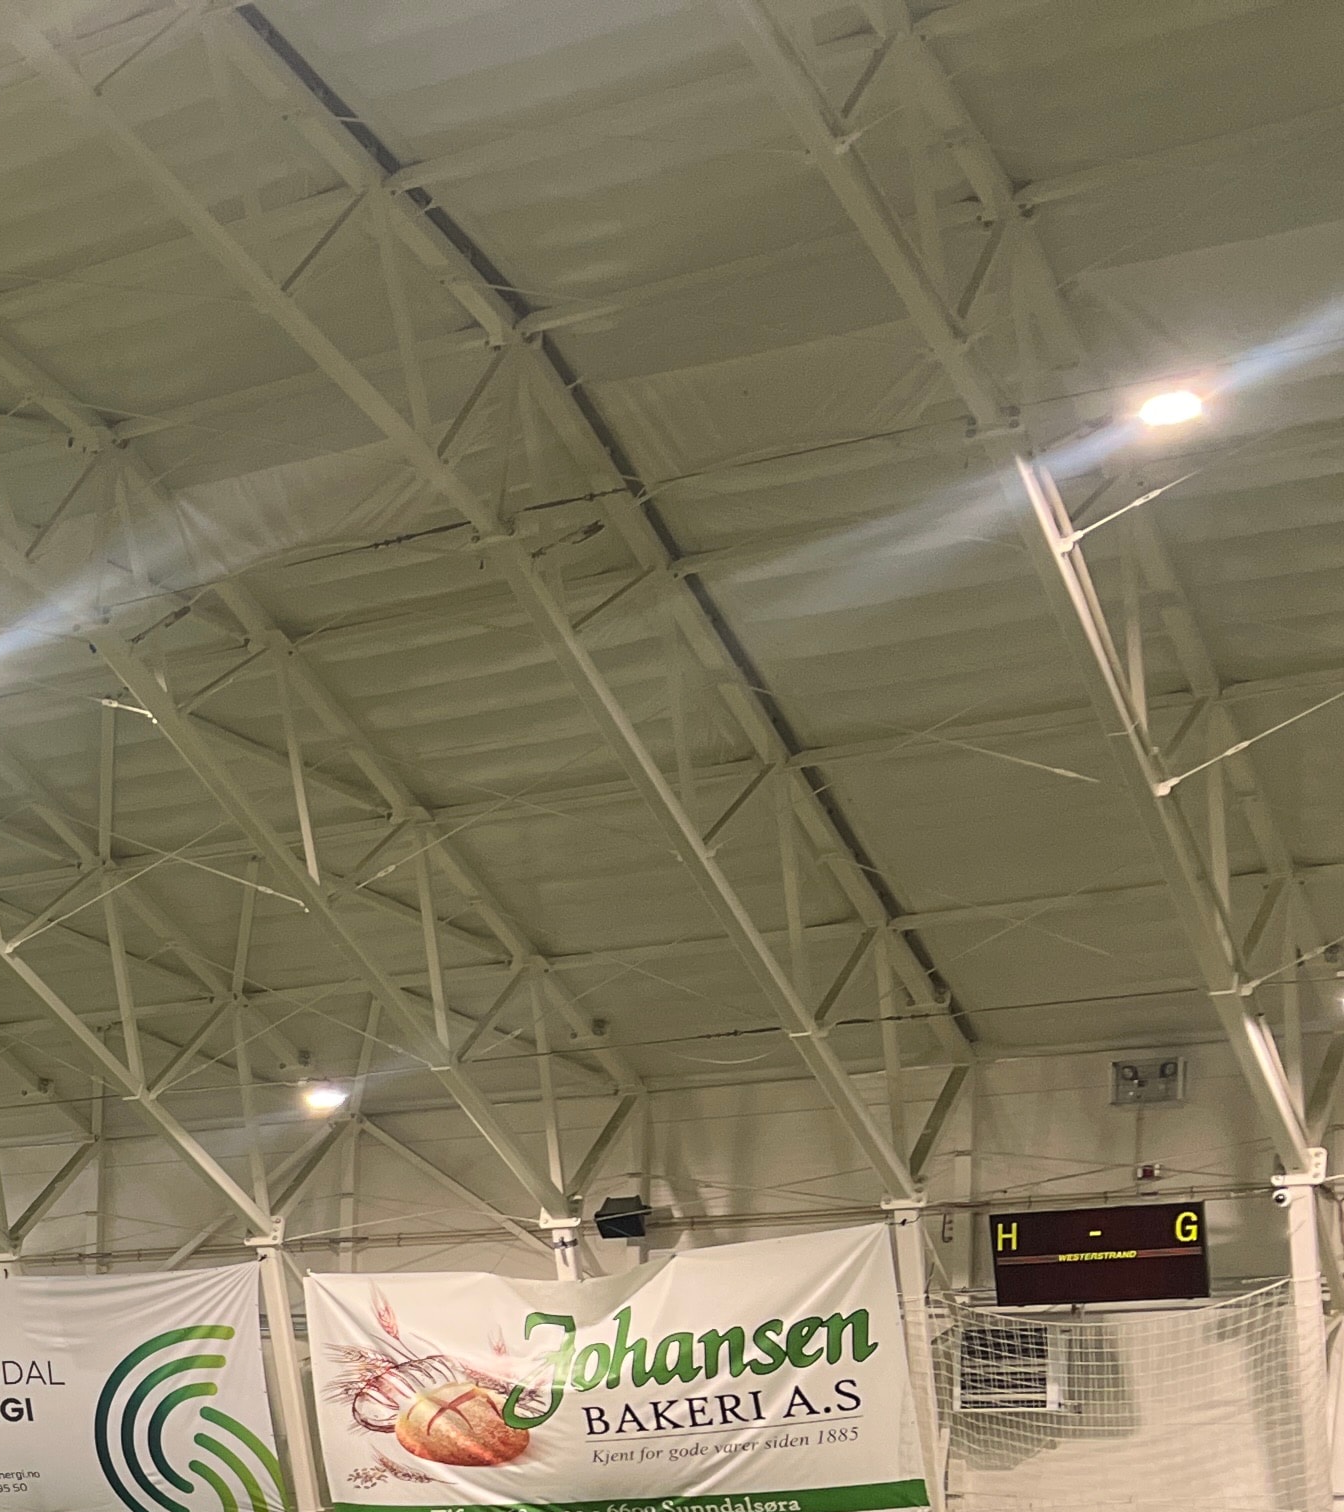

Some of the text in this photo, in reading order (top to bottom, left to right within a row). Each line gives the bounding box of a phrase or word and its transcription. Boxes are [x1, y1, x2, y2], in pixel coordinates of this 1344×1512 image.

[997, 1222, 1017, 1251] H
[1175, 1211, 1198, 1242] G
[1058, 1250, 1137, 1263] WESTERSTRAND
[502, 1305, 879, 1430] Johansen
[581, 1379, 862, 1436] BAKERI A.S
[592, 1426, 859, 1467] Kjent for gode varer siden 1885
[12, 1482, 28, 1492] 50
